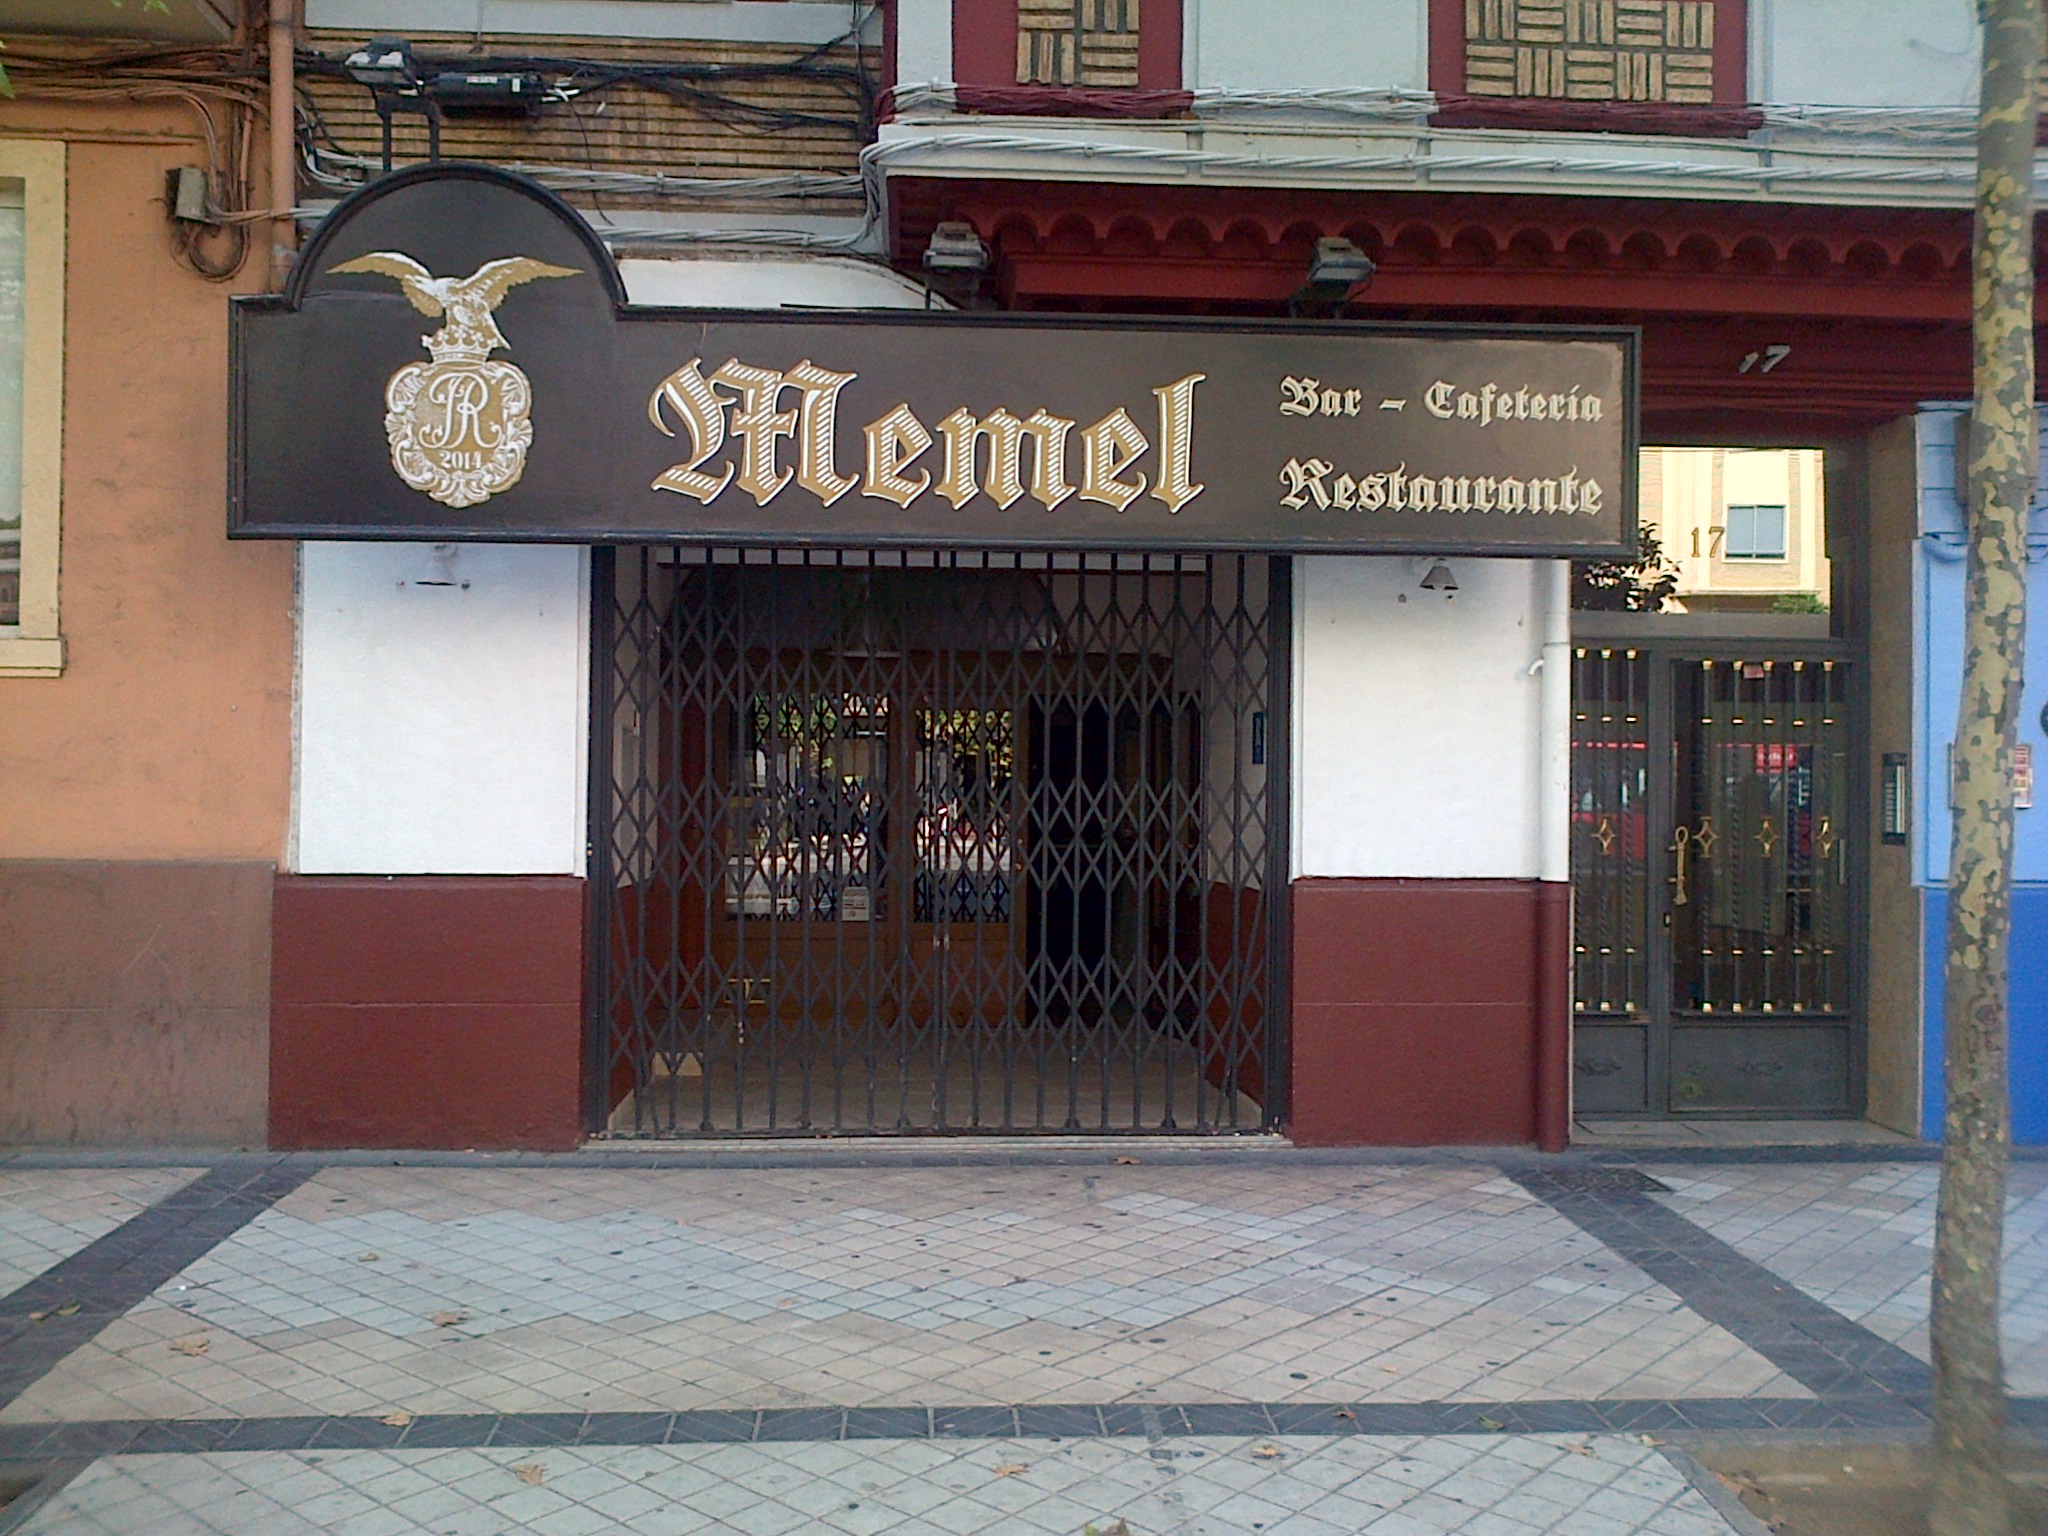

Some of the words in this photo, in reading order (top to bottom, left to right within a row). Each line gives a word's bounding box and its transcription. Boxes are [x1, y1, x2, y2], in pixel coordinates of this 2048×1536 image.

[1738, 344, 1791, 374] 17
[1279, 375, 1363, 417] Bar
[1424, 380, 1604, 428] Cafetería
[648, 357, 1206, 514] Memel
[439, 450, 482, 470] 2014
[1278, 457, 1604, 516] Restaurante
[1691, 525, 1726, 558] 17
